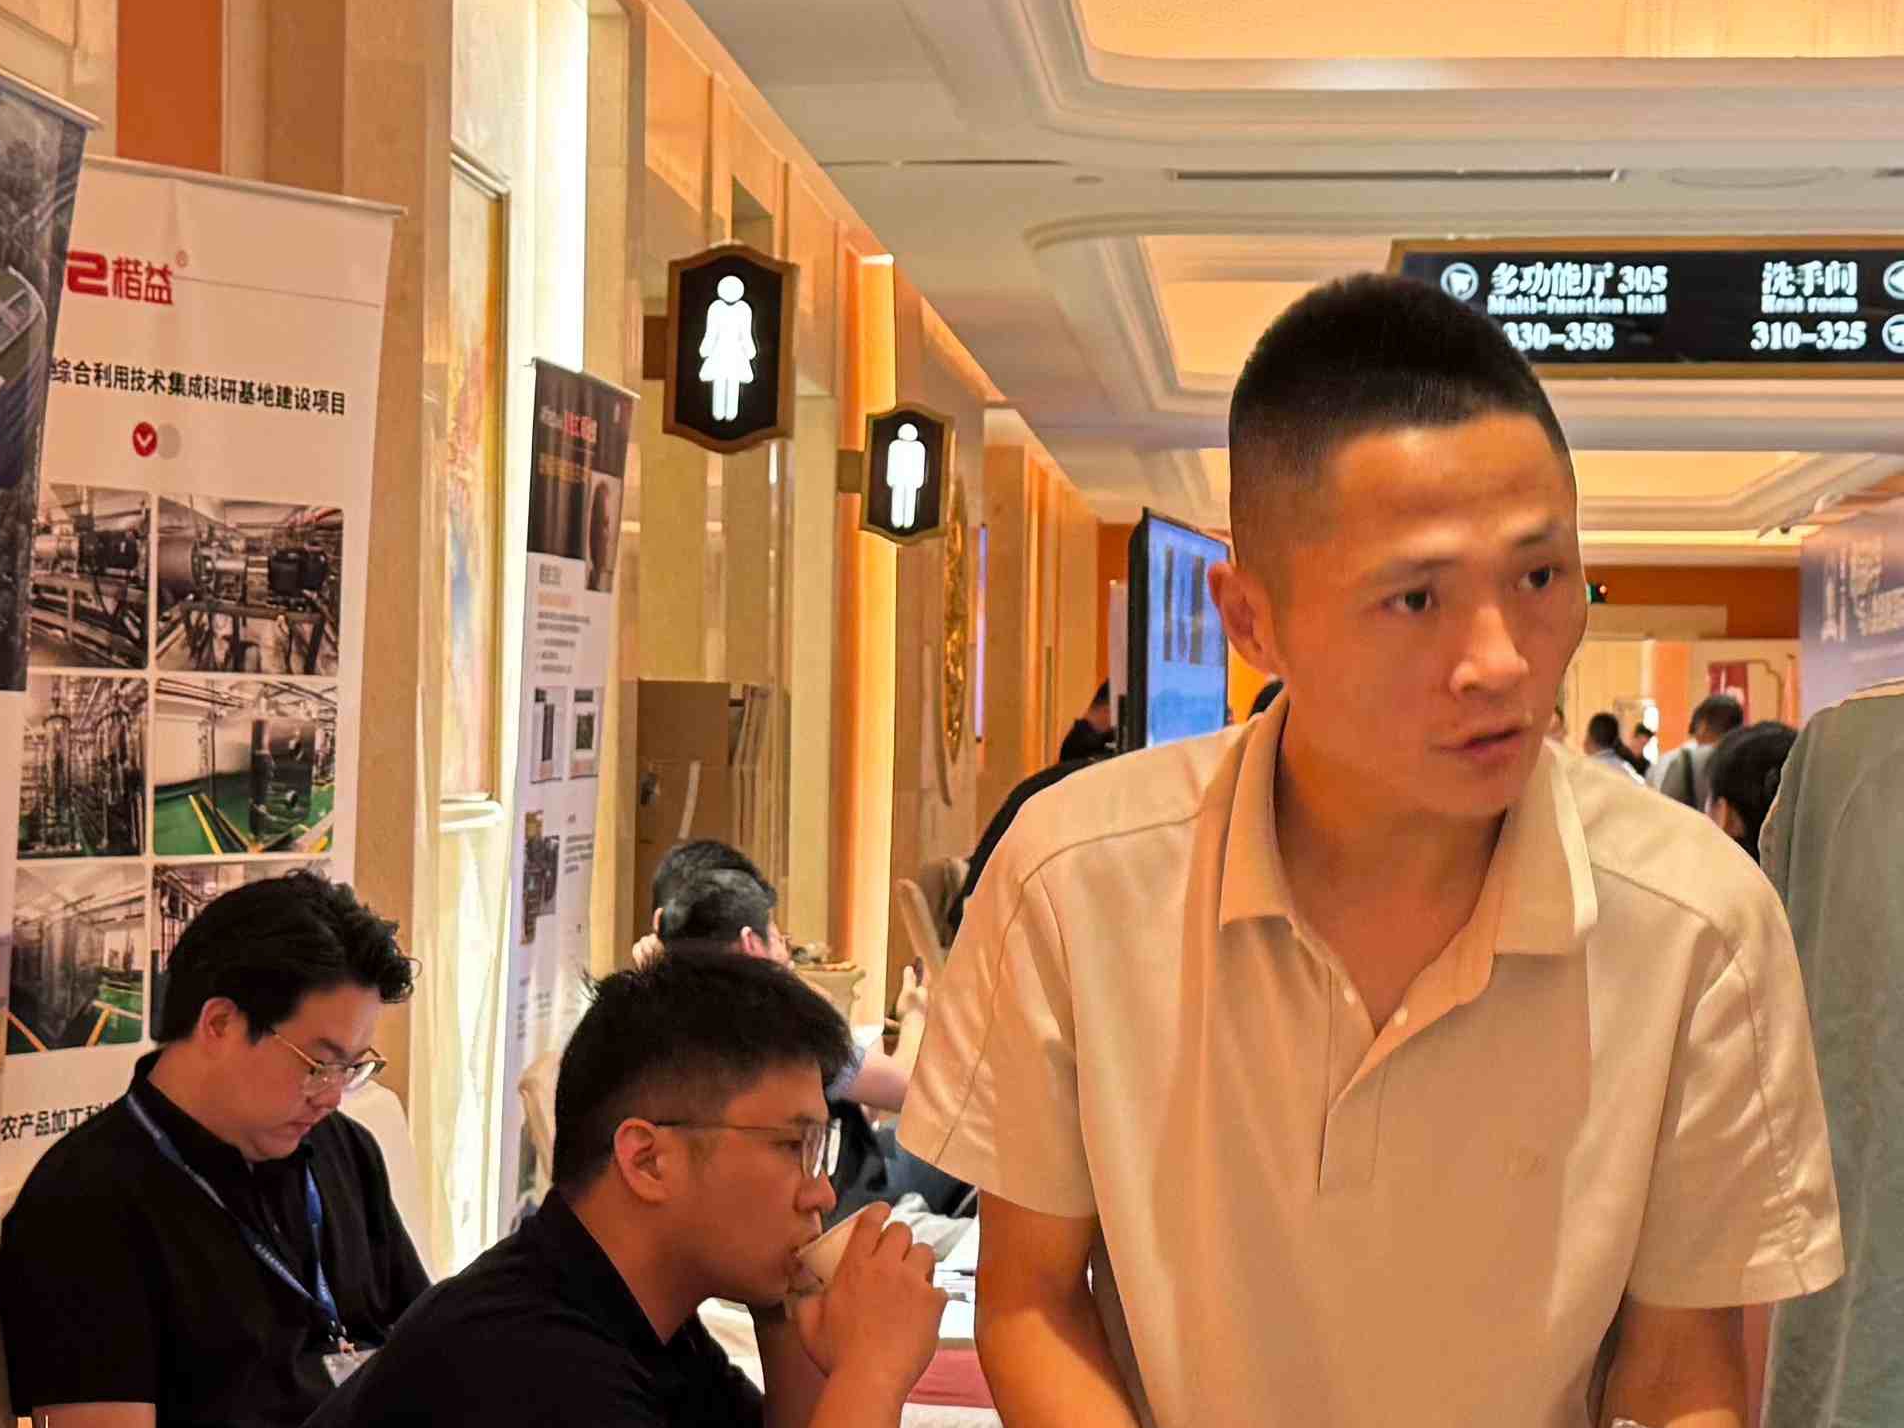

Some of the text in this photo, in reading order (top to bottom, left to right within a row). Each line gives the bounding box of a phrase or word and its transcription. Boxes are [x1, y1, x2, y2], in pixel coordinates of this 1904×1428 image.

[1490, 261, 1668, 296] 多功能厅 305
[1761, 260, 1859, 296] 洗手间
[1626, 293, 1668, 315] Hall
[1502, 321, 1615, 351] 330-358
[1750, 320, 1868, 351] 310-325
